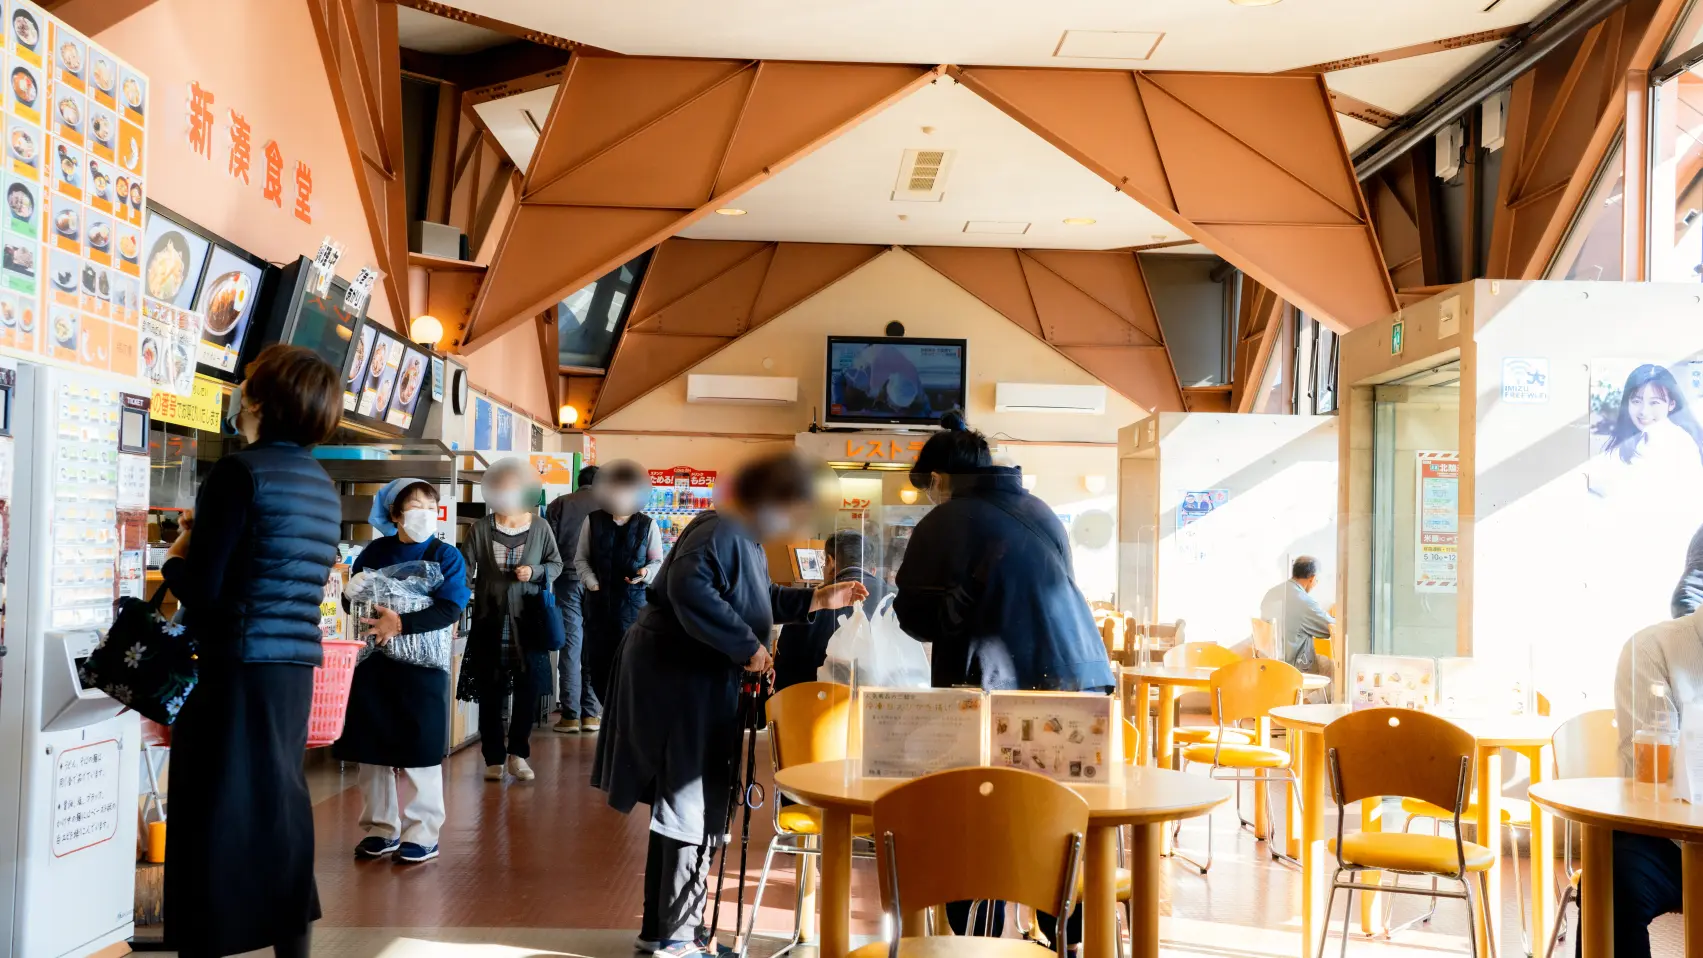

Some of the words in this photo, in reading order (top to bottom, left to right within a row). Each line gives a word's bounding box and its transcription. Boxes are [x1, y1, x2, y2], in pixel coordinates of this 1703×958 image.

[188, 81, 312, 225] 新湊食堂
[126, 397, 144, 406] TICKET
